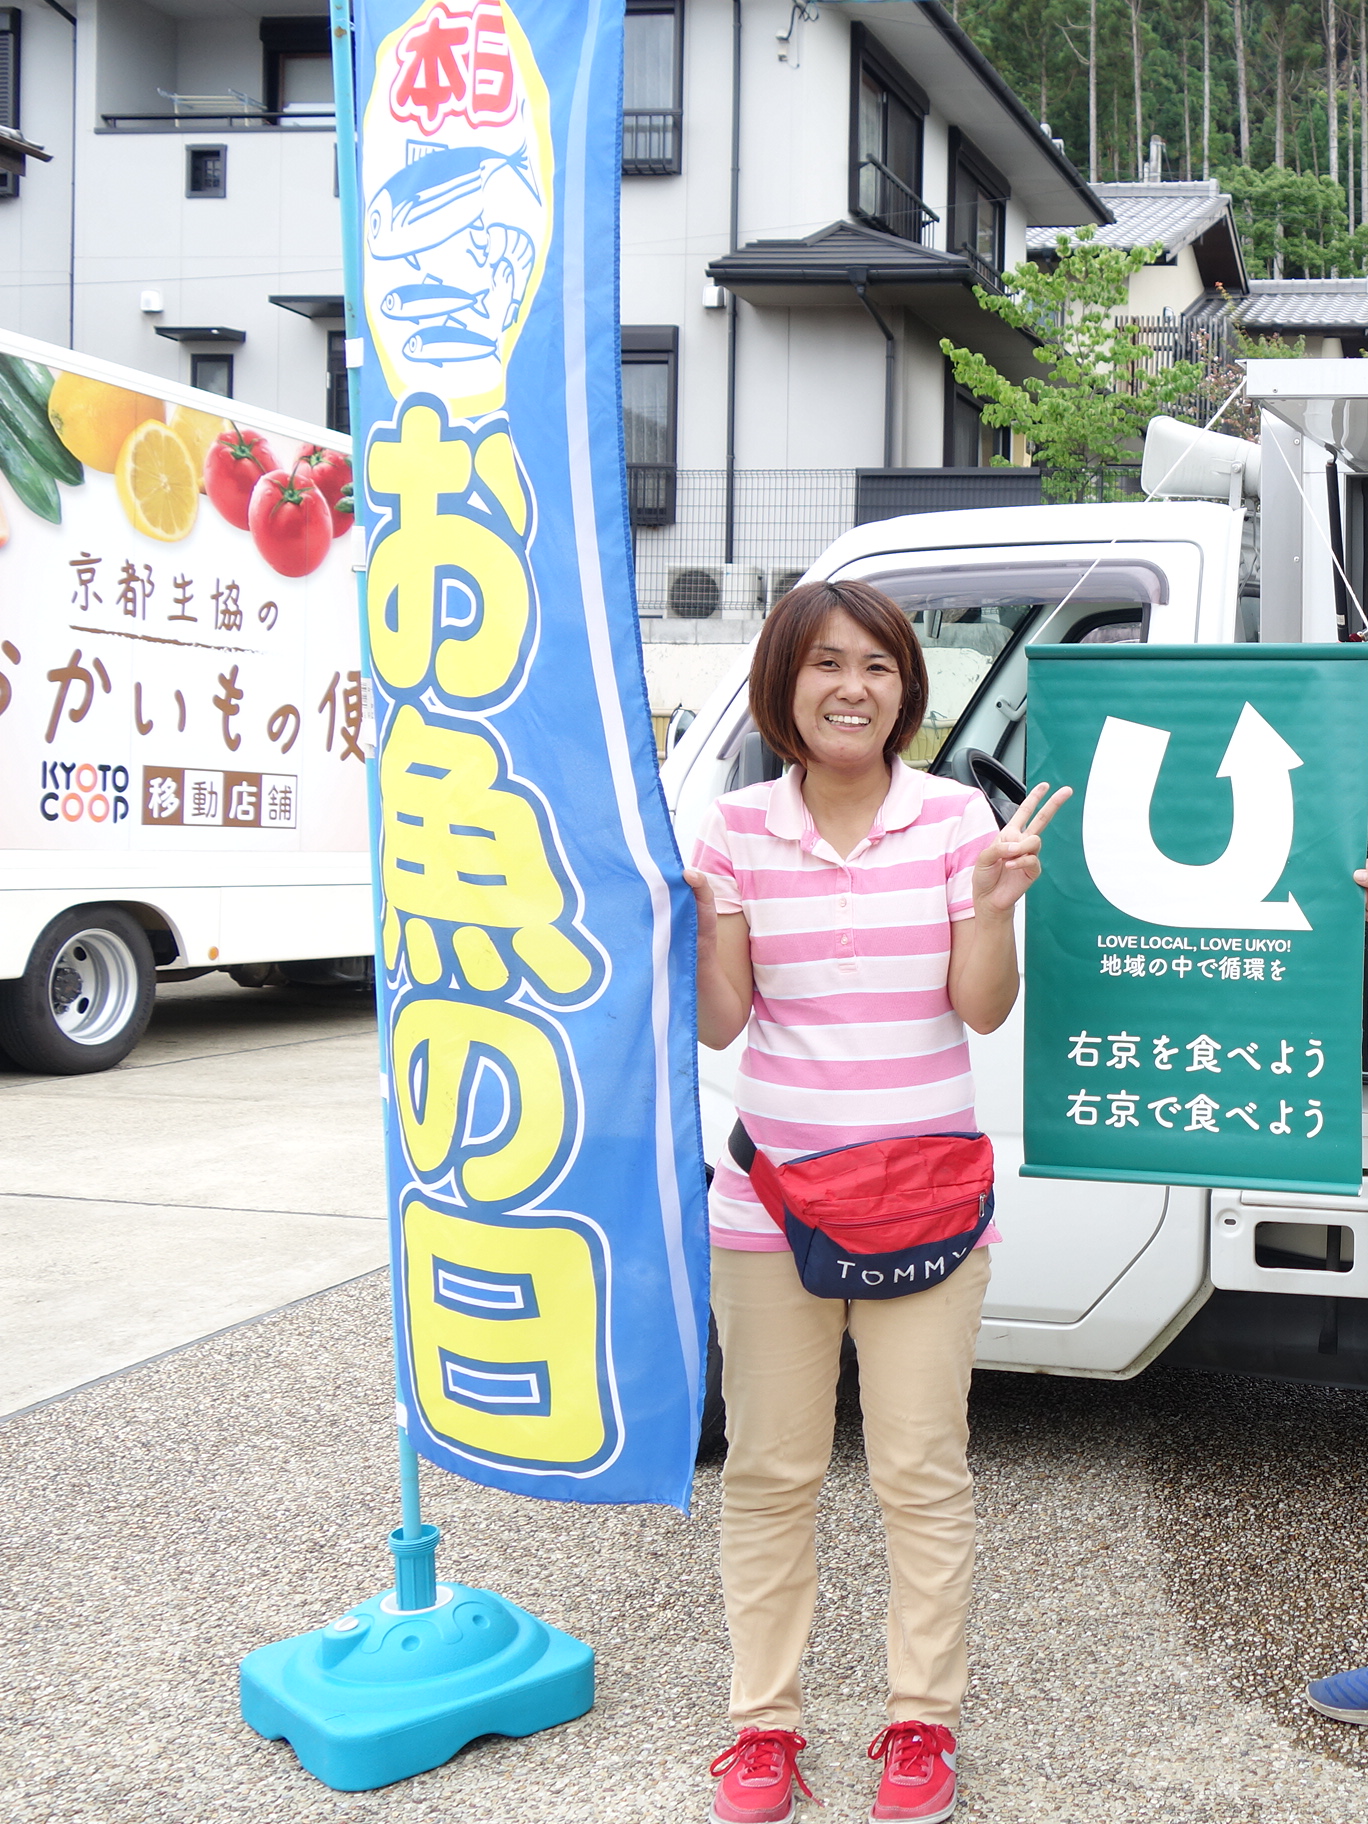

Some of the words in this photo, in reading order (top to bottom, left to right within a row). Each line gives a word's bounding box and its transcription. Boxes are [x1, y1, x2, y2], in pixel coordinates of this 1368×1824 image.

[393, 5, 517, 131] 本日
[69, 551, 279, 632] 京都生協の
[41, 760, 129, 793] KYOTO
[148, 776, 293, 822] 移動店舗
[40, 791, 129, 823] COOP
[366, 400, 612, 1470] お魚の日
[1097, 935, 1138, 949] LOVE
[1140, 936, 1197, 952] LOCAL,
[1200, 937, 1242, 951] LOVE
[1245, 938, 1291, 953] UKYO!
[1100, 954, 1286, 981] 地域の中で循環を
[1067, 1030, 1325, 1078] 右京を食べよう
[1066, 1088, 1325, 1139] 右京で食べよう
